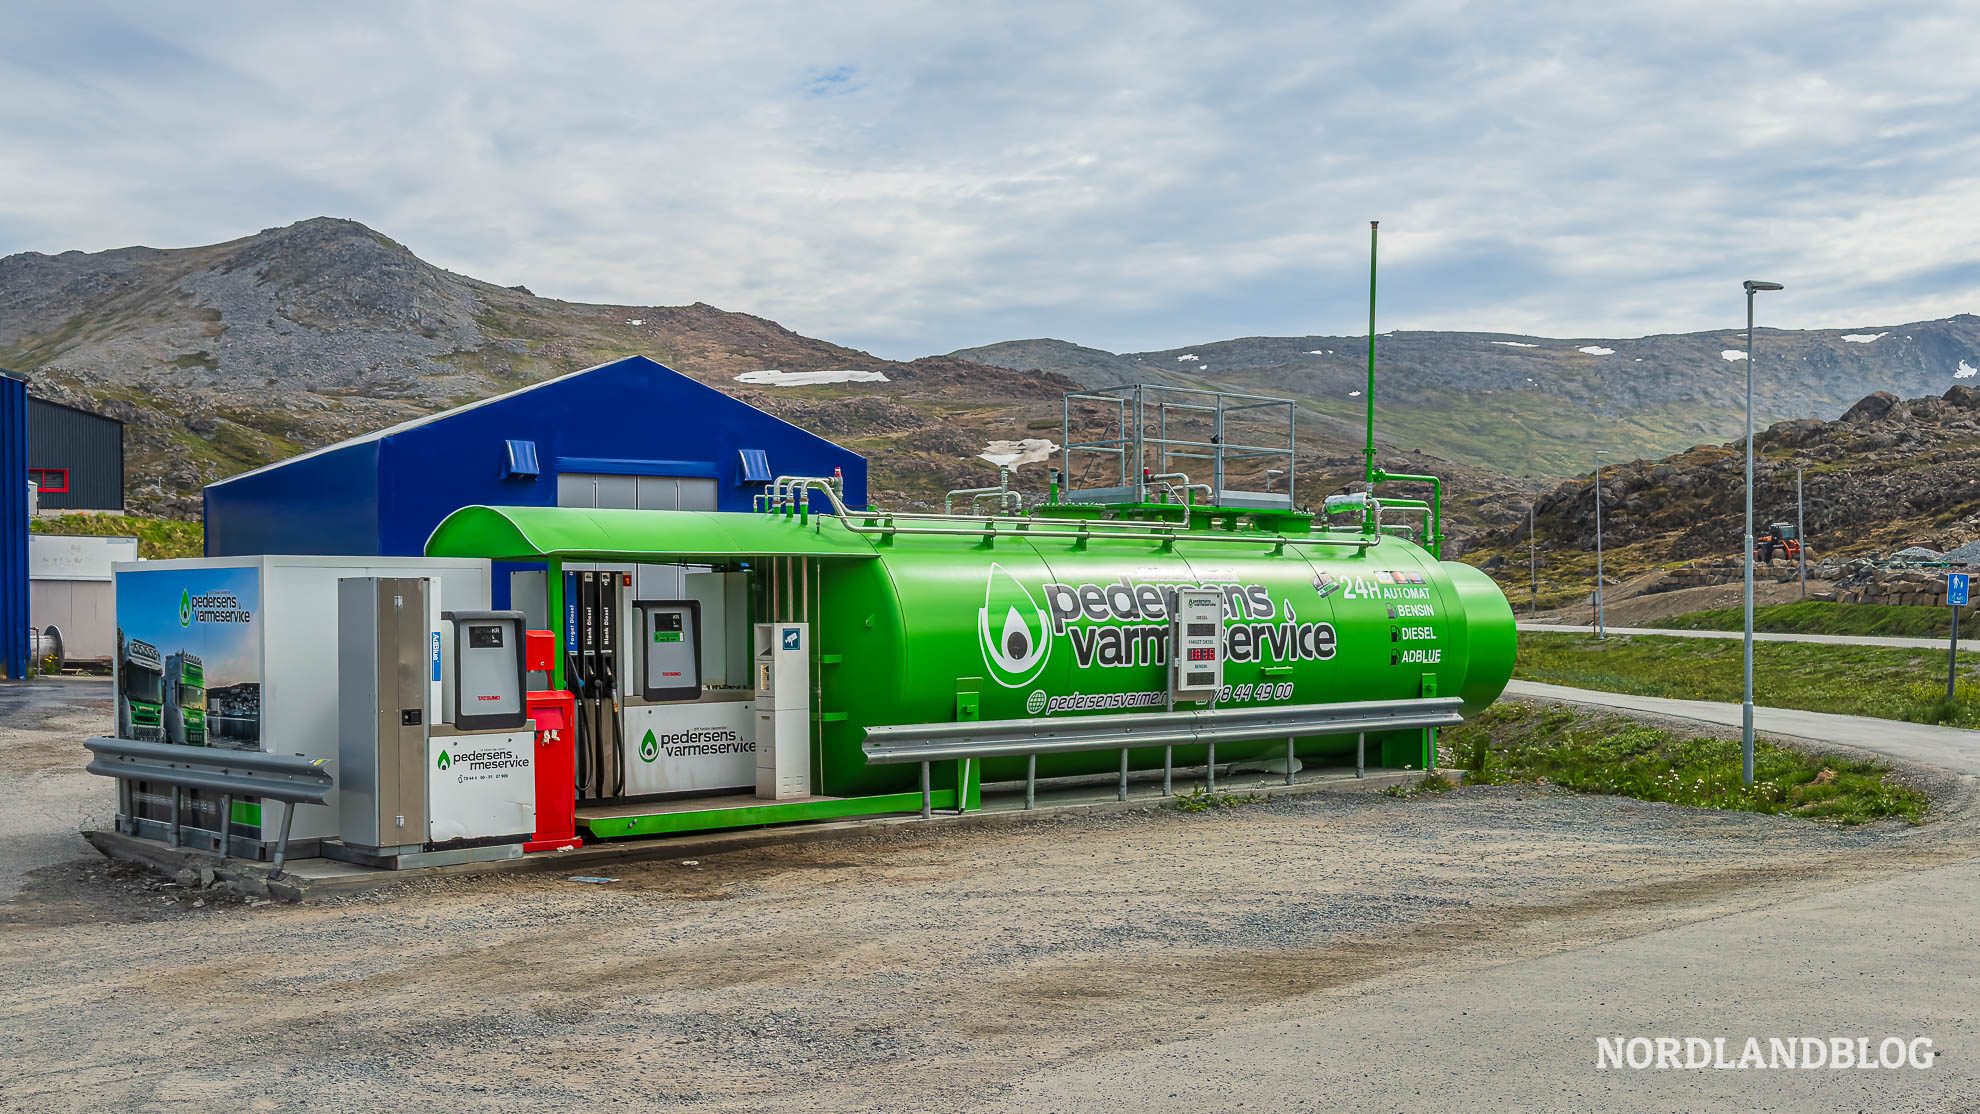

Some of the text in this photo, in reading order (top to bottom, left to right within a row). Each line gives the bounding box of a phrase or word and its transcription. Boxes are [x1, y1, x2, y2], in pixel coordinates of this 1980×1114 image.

[1340, 575, 1430, 599] 24H AUTOMAT
[192, 592, 237, 611] pedersens
[1043, 575, 1275, 635] pederns
[1397, 604, 1434, 617] BENSIN
[195, 603, 251, 623] varmeservice
[1069, 599, 1337, 668] varmervice
[1401, 627, 1437, 640] DIESEL
[1401, 649, 1441, 663] ADBLUE
[1234, 683, 1252, 701] 44
[1255, 682, 1274, 700] 49
[1274, 682, 1293, 700] 00
[660, 729, 736, 748] pedersens
[666, 736, 756, 757] varmeservice
[453, 750, 512, 765] pedersens
